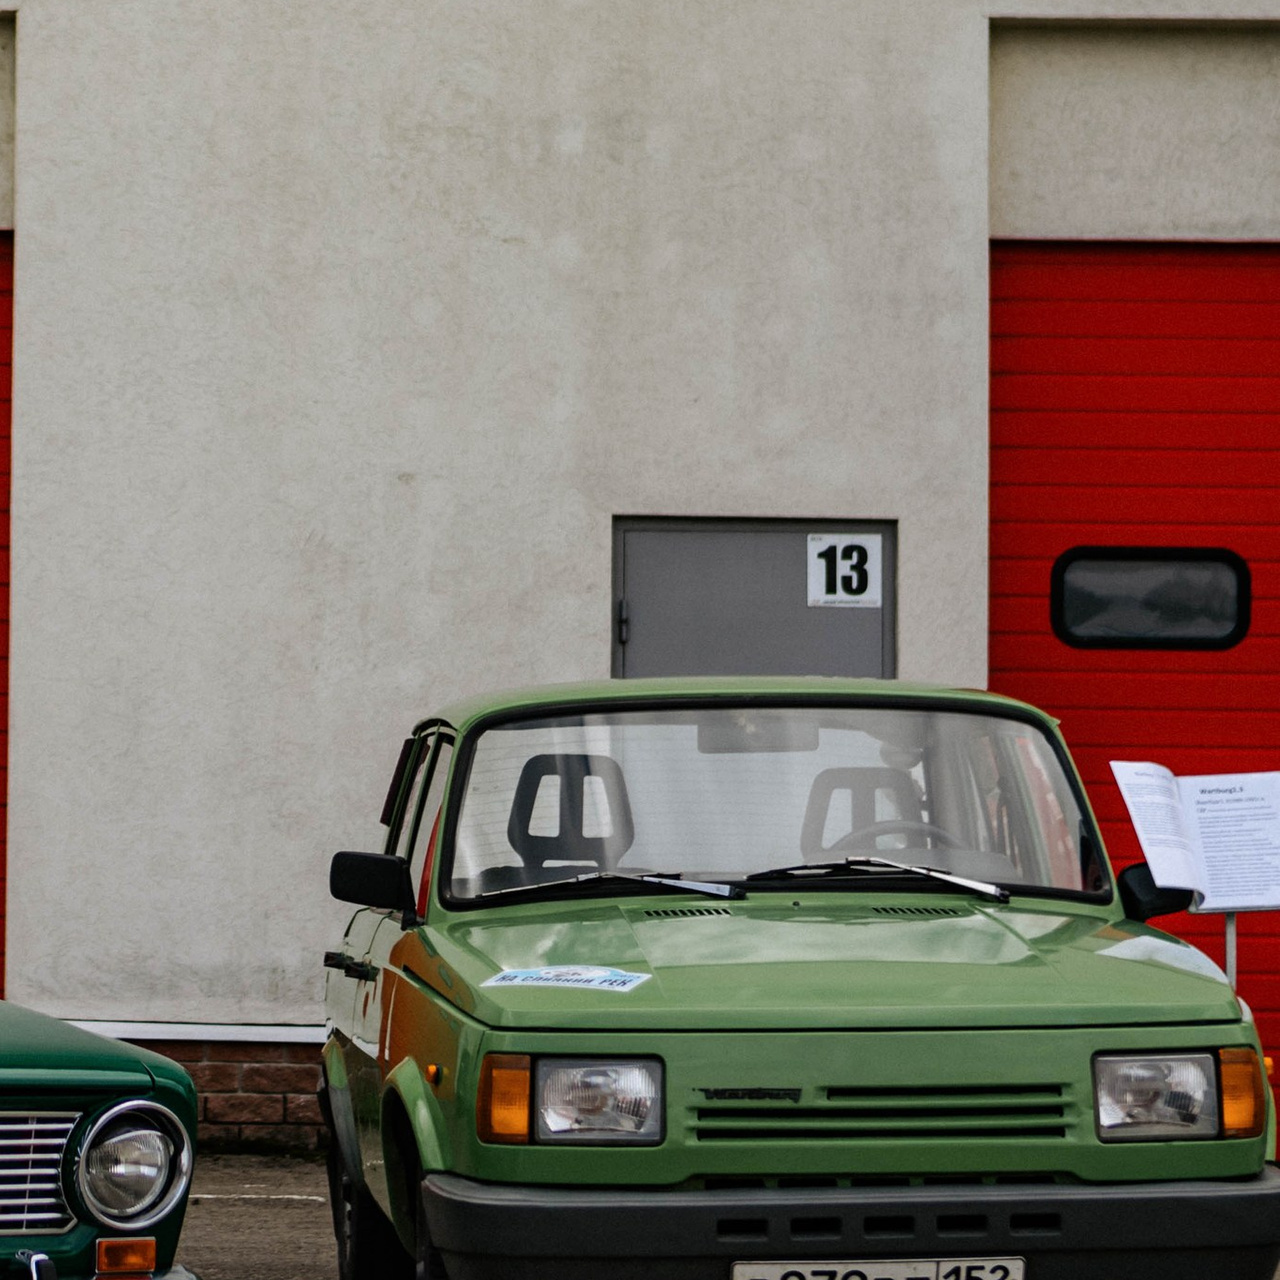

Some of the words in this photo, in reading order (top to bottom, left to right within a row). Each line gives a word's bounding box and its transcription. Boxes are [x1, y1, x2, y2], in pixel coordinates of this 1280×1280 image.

[817, 544, 868, 596] 13
[495, 974, 518, 983] НА
[599, 978, 634, 987] РЕК
